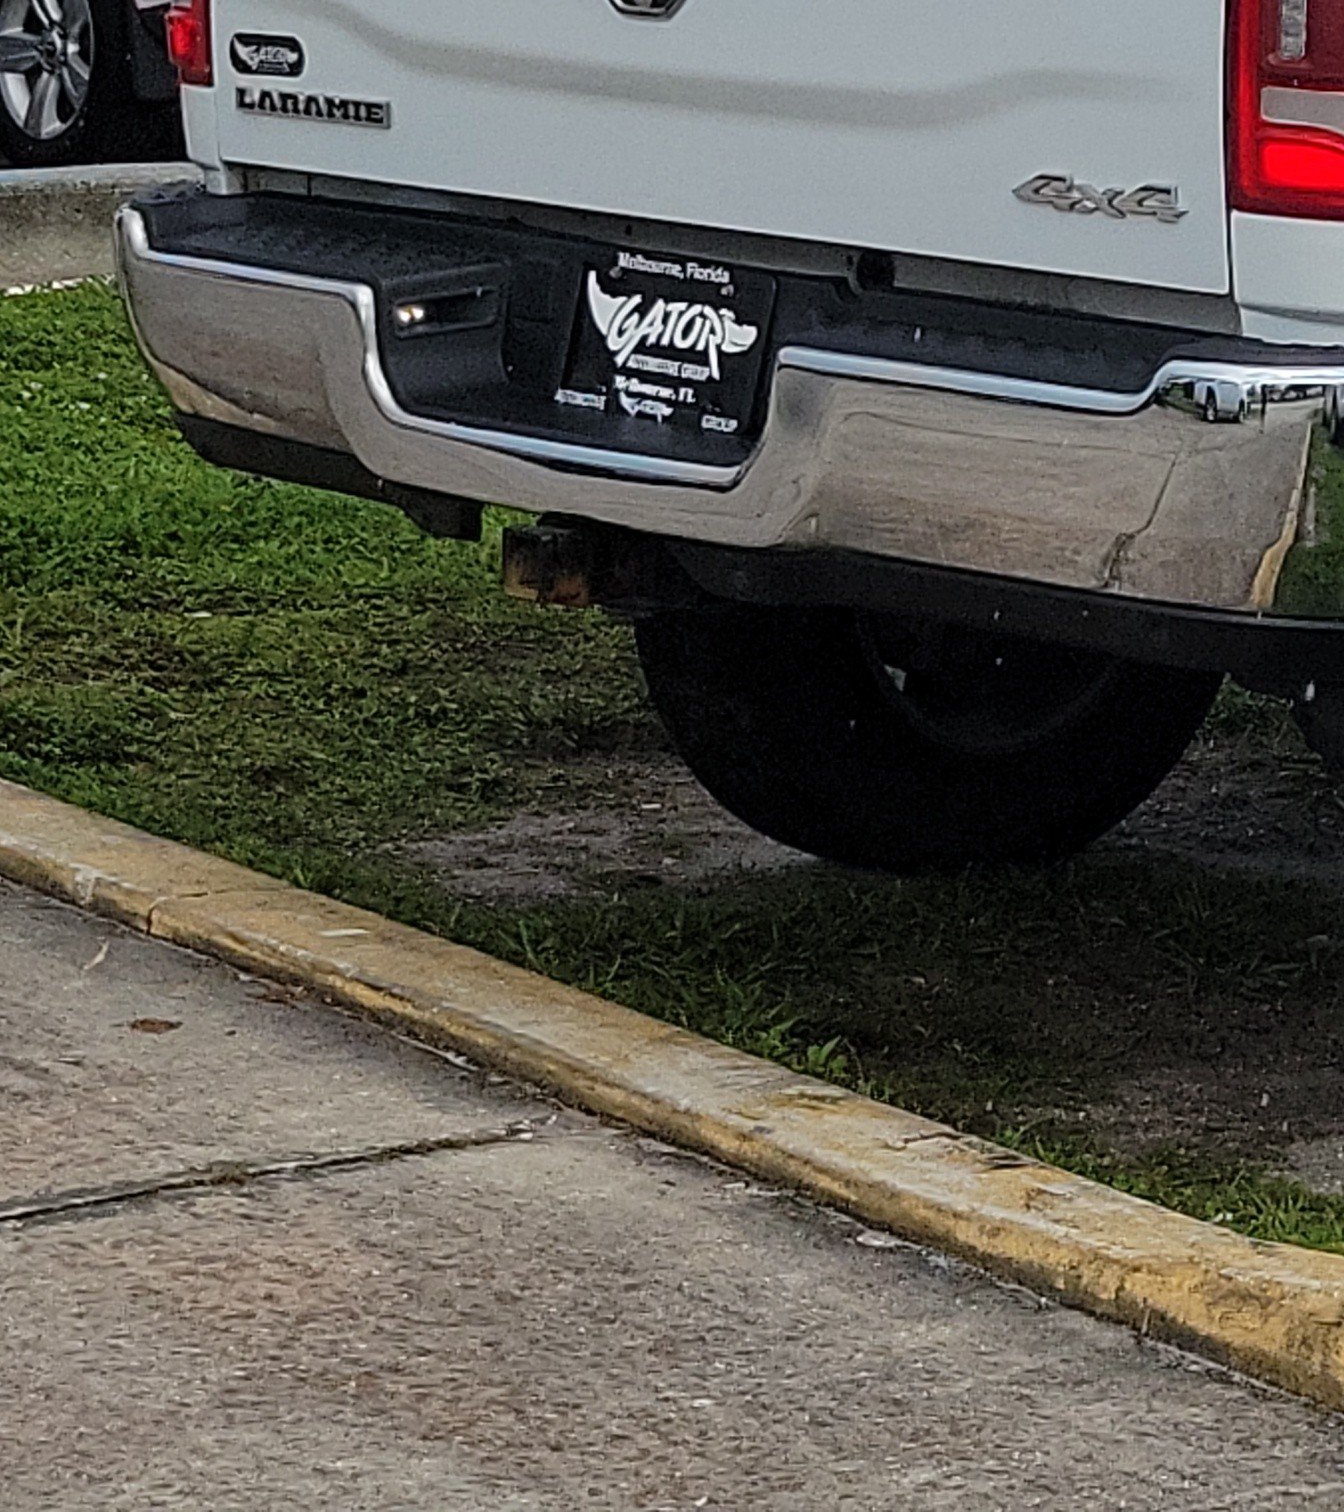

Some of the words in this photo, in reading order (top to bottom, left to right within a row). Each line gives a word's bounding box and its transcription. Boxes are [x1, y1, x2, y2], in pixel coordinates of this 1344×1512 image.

[236, 86, 388, 126] LARAMIE
[686, 262, 730, 284] Florida
[606, 293, 725, 381] GATOR
